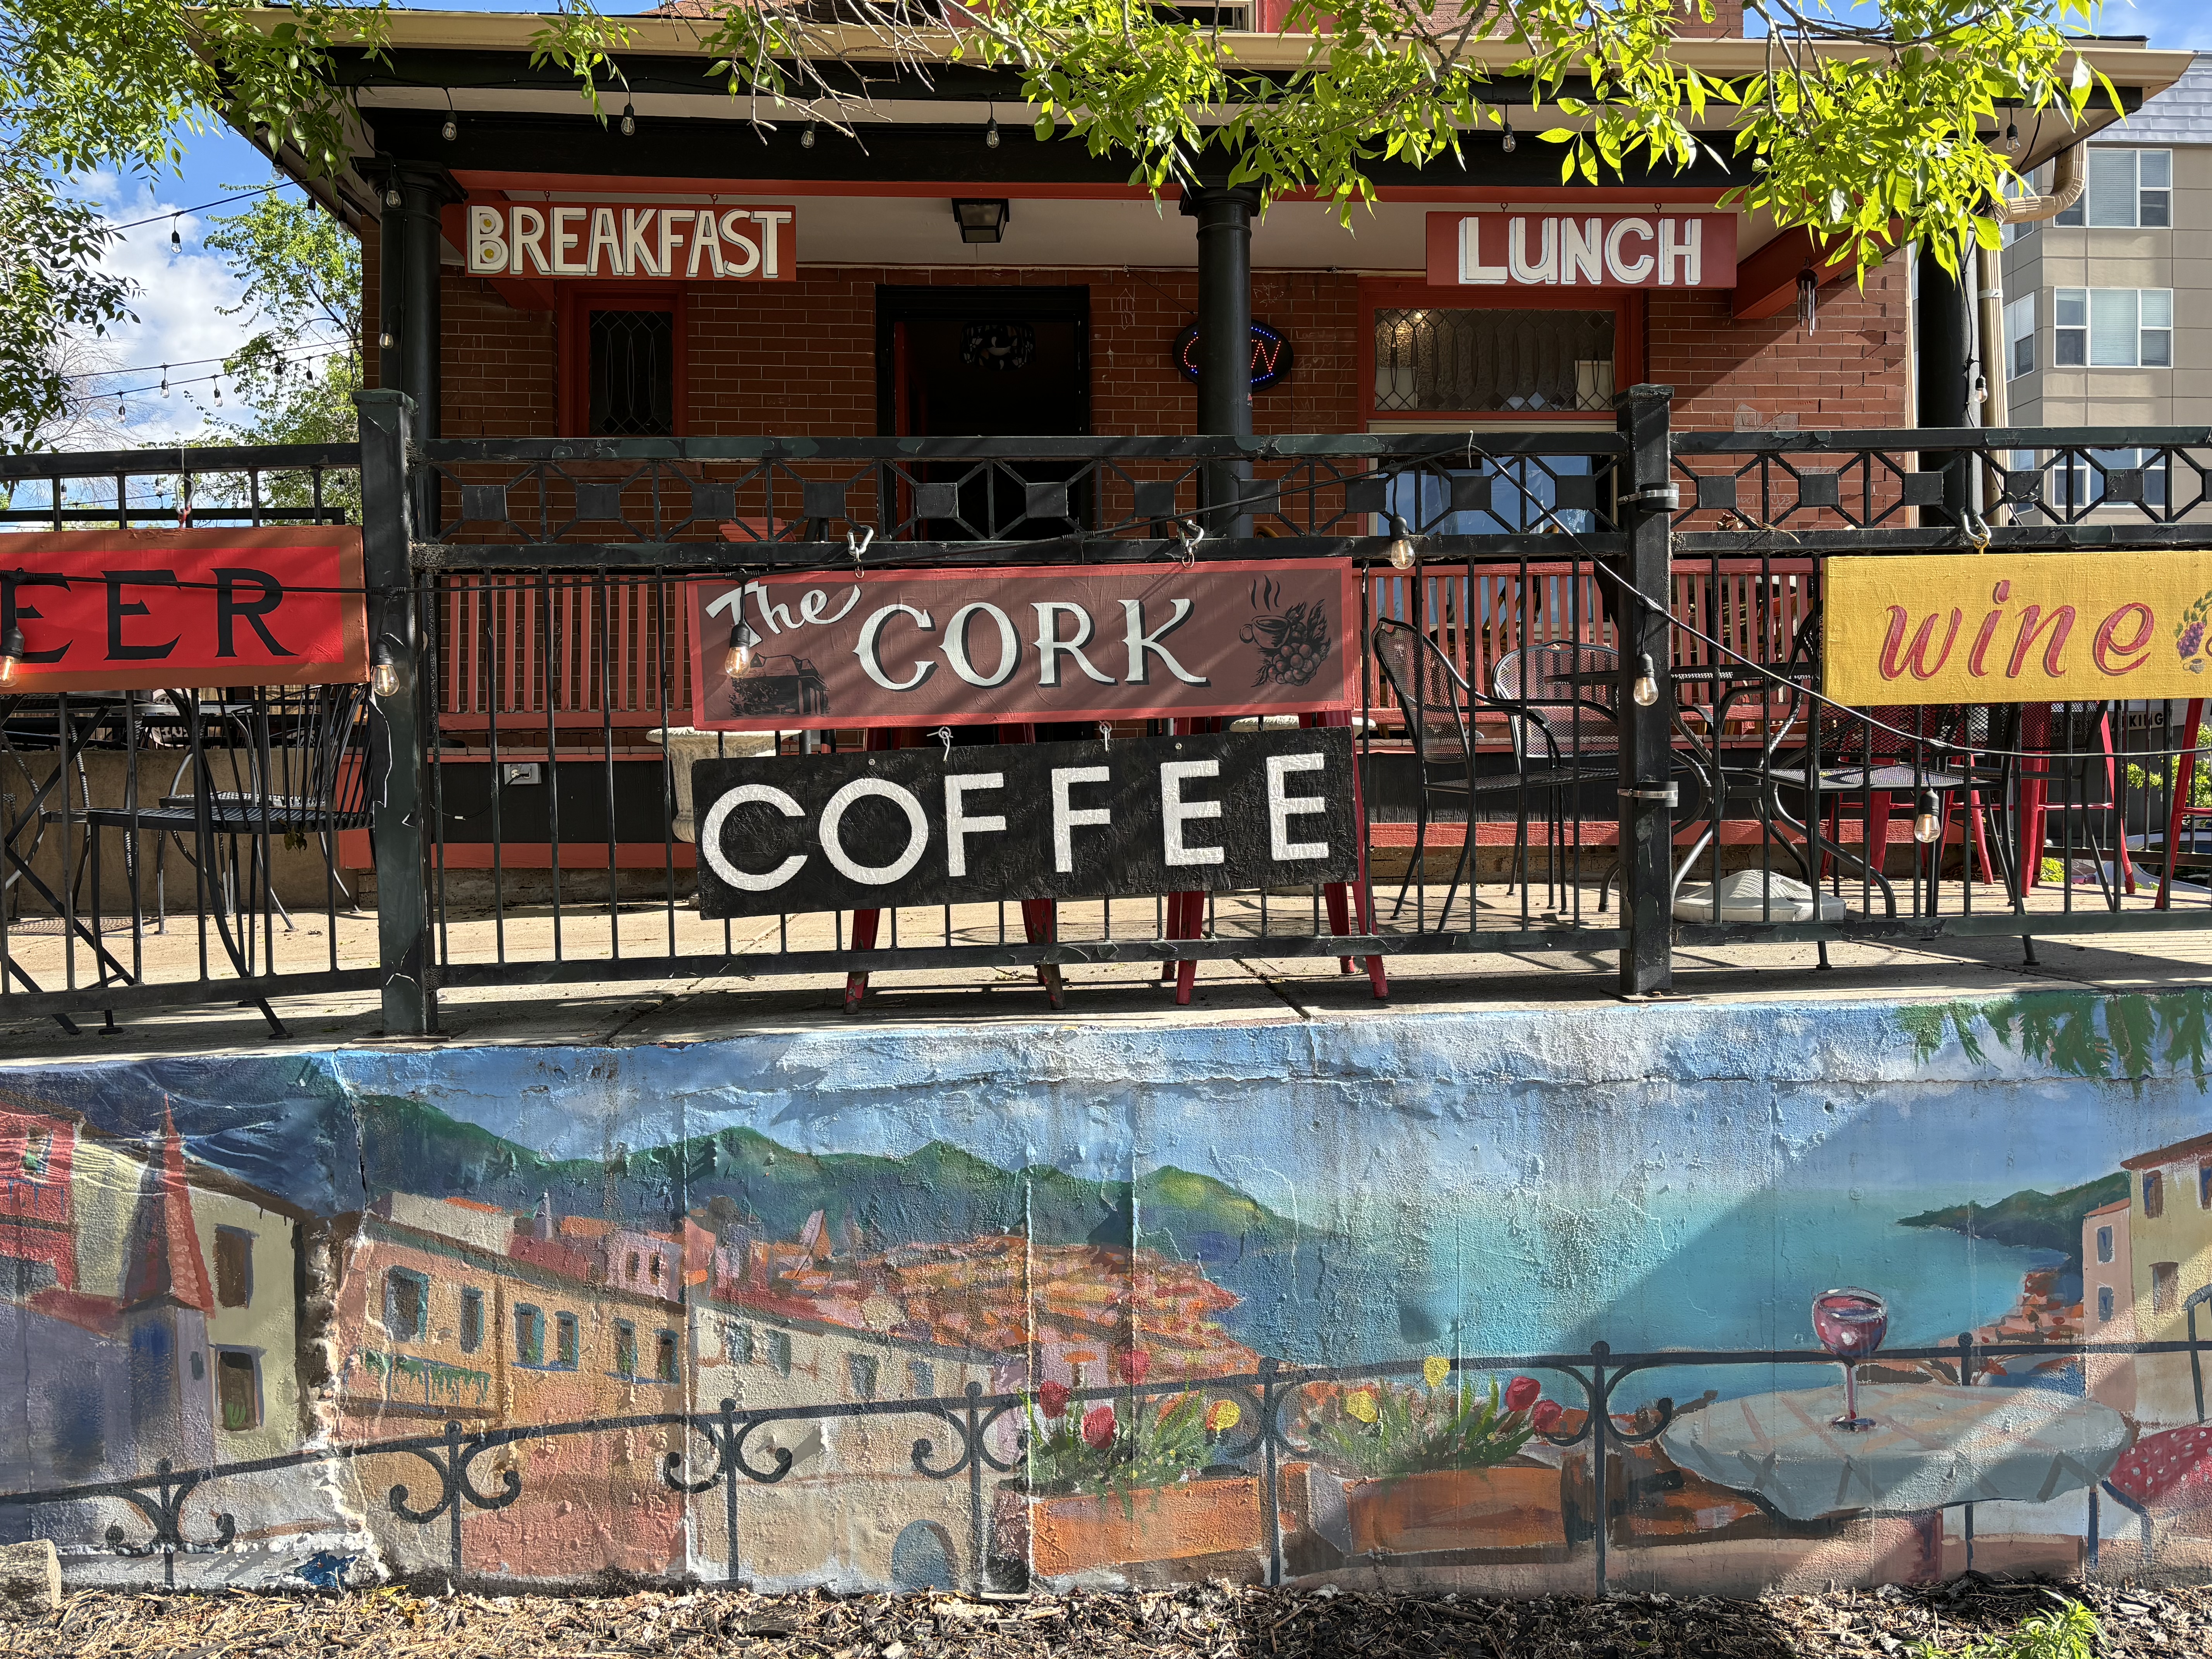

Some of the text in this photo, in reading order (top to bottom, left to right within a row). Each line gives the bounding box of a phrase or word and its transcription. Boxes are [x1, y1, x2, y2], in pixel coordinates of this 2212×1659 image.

[466, 205, 792, 277] BREAKFAST
[1458, 216, 1702, 285] LUNCH
[705, 581, 1211, 692] The CORK
[1879, 579, 2154, 681] wine
[702, 753, 1330, 891] COFFEE
